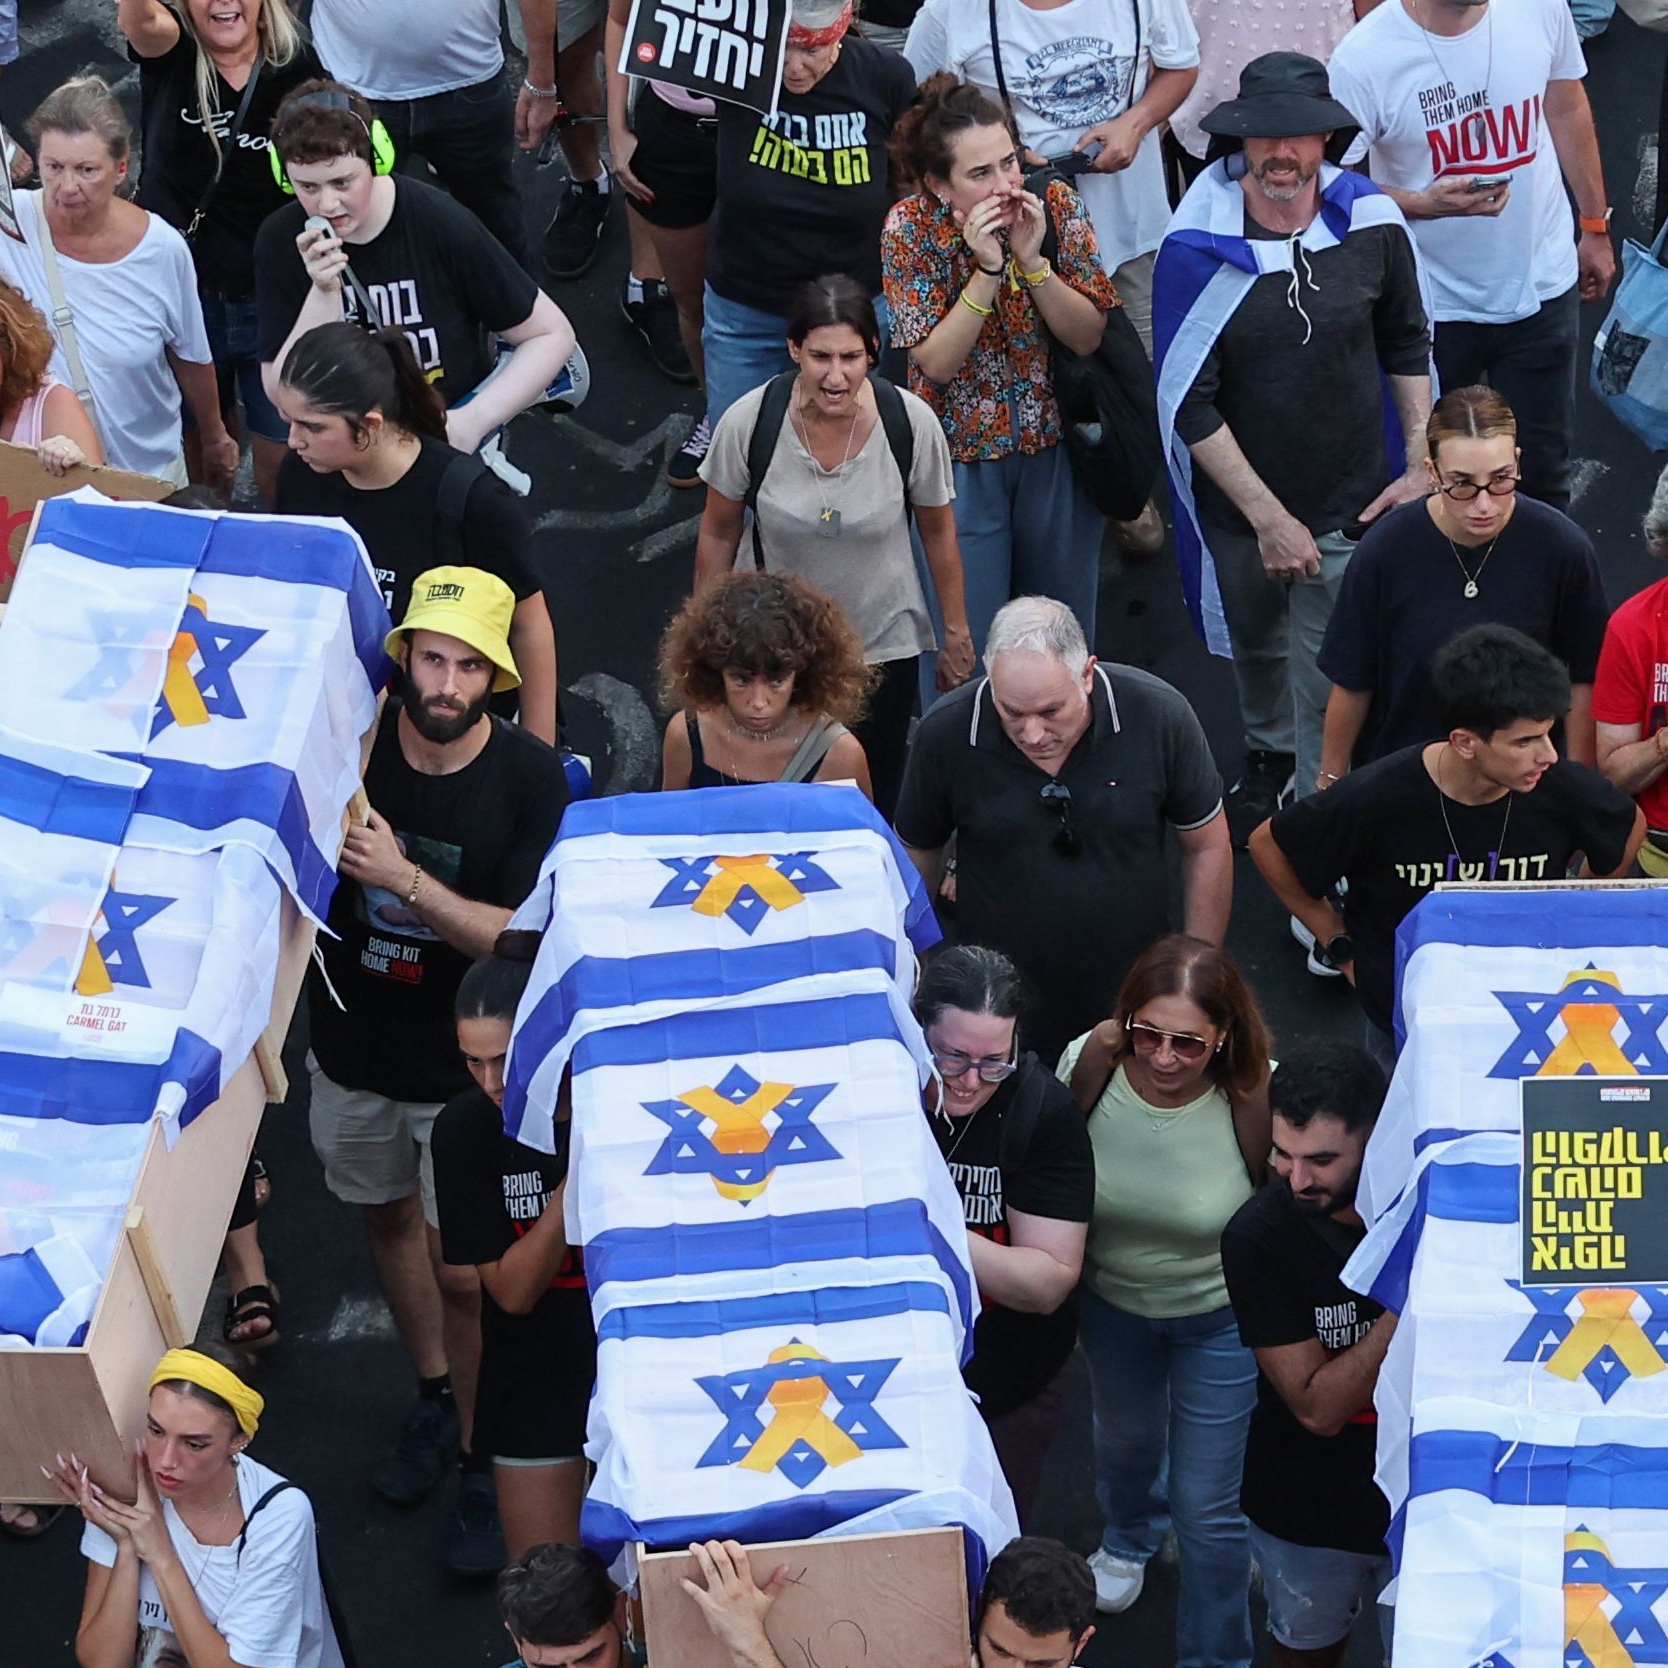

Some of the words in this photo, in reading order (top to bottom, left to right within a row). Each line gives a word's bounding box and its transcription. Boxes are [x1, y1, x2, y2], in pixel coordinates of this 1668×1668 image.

[653, 9, 764, 90] יחזיר
[1418, 81, 1456, 109] BRING
[1422, 103, 1455, 127] THEM
[1457, 89, 1490, 115] HOME
[814, 111, 868, 150] אתם
[748, 127, 828, 184] בעזה!
[832, 147, 871, 185] הם
[360, 949, 390, 973] HOME
[368, 936, 401, 959] BRING
[402, 945, 421, 963] KIT
[66, 1015, 104, 1031] CARMEL
[107, 1020, 127, 1032] GAT
[502, 1171, 543, 1196] BRING
[1531, 1166, 1643, 1199] כשהם
[505, 1197, 540, 1220] THEM
[964, 1194, 1003, 1225] אותם
[1531, 1200, 1614, 1234] היית
[1531, 1234, 1626, 1271] איפה
[1315, 1301, 1357, 1329] BRING
[1317, 1323, 1351, 1349] THEM
